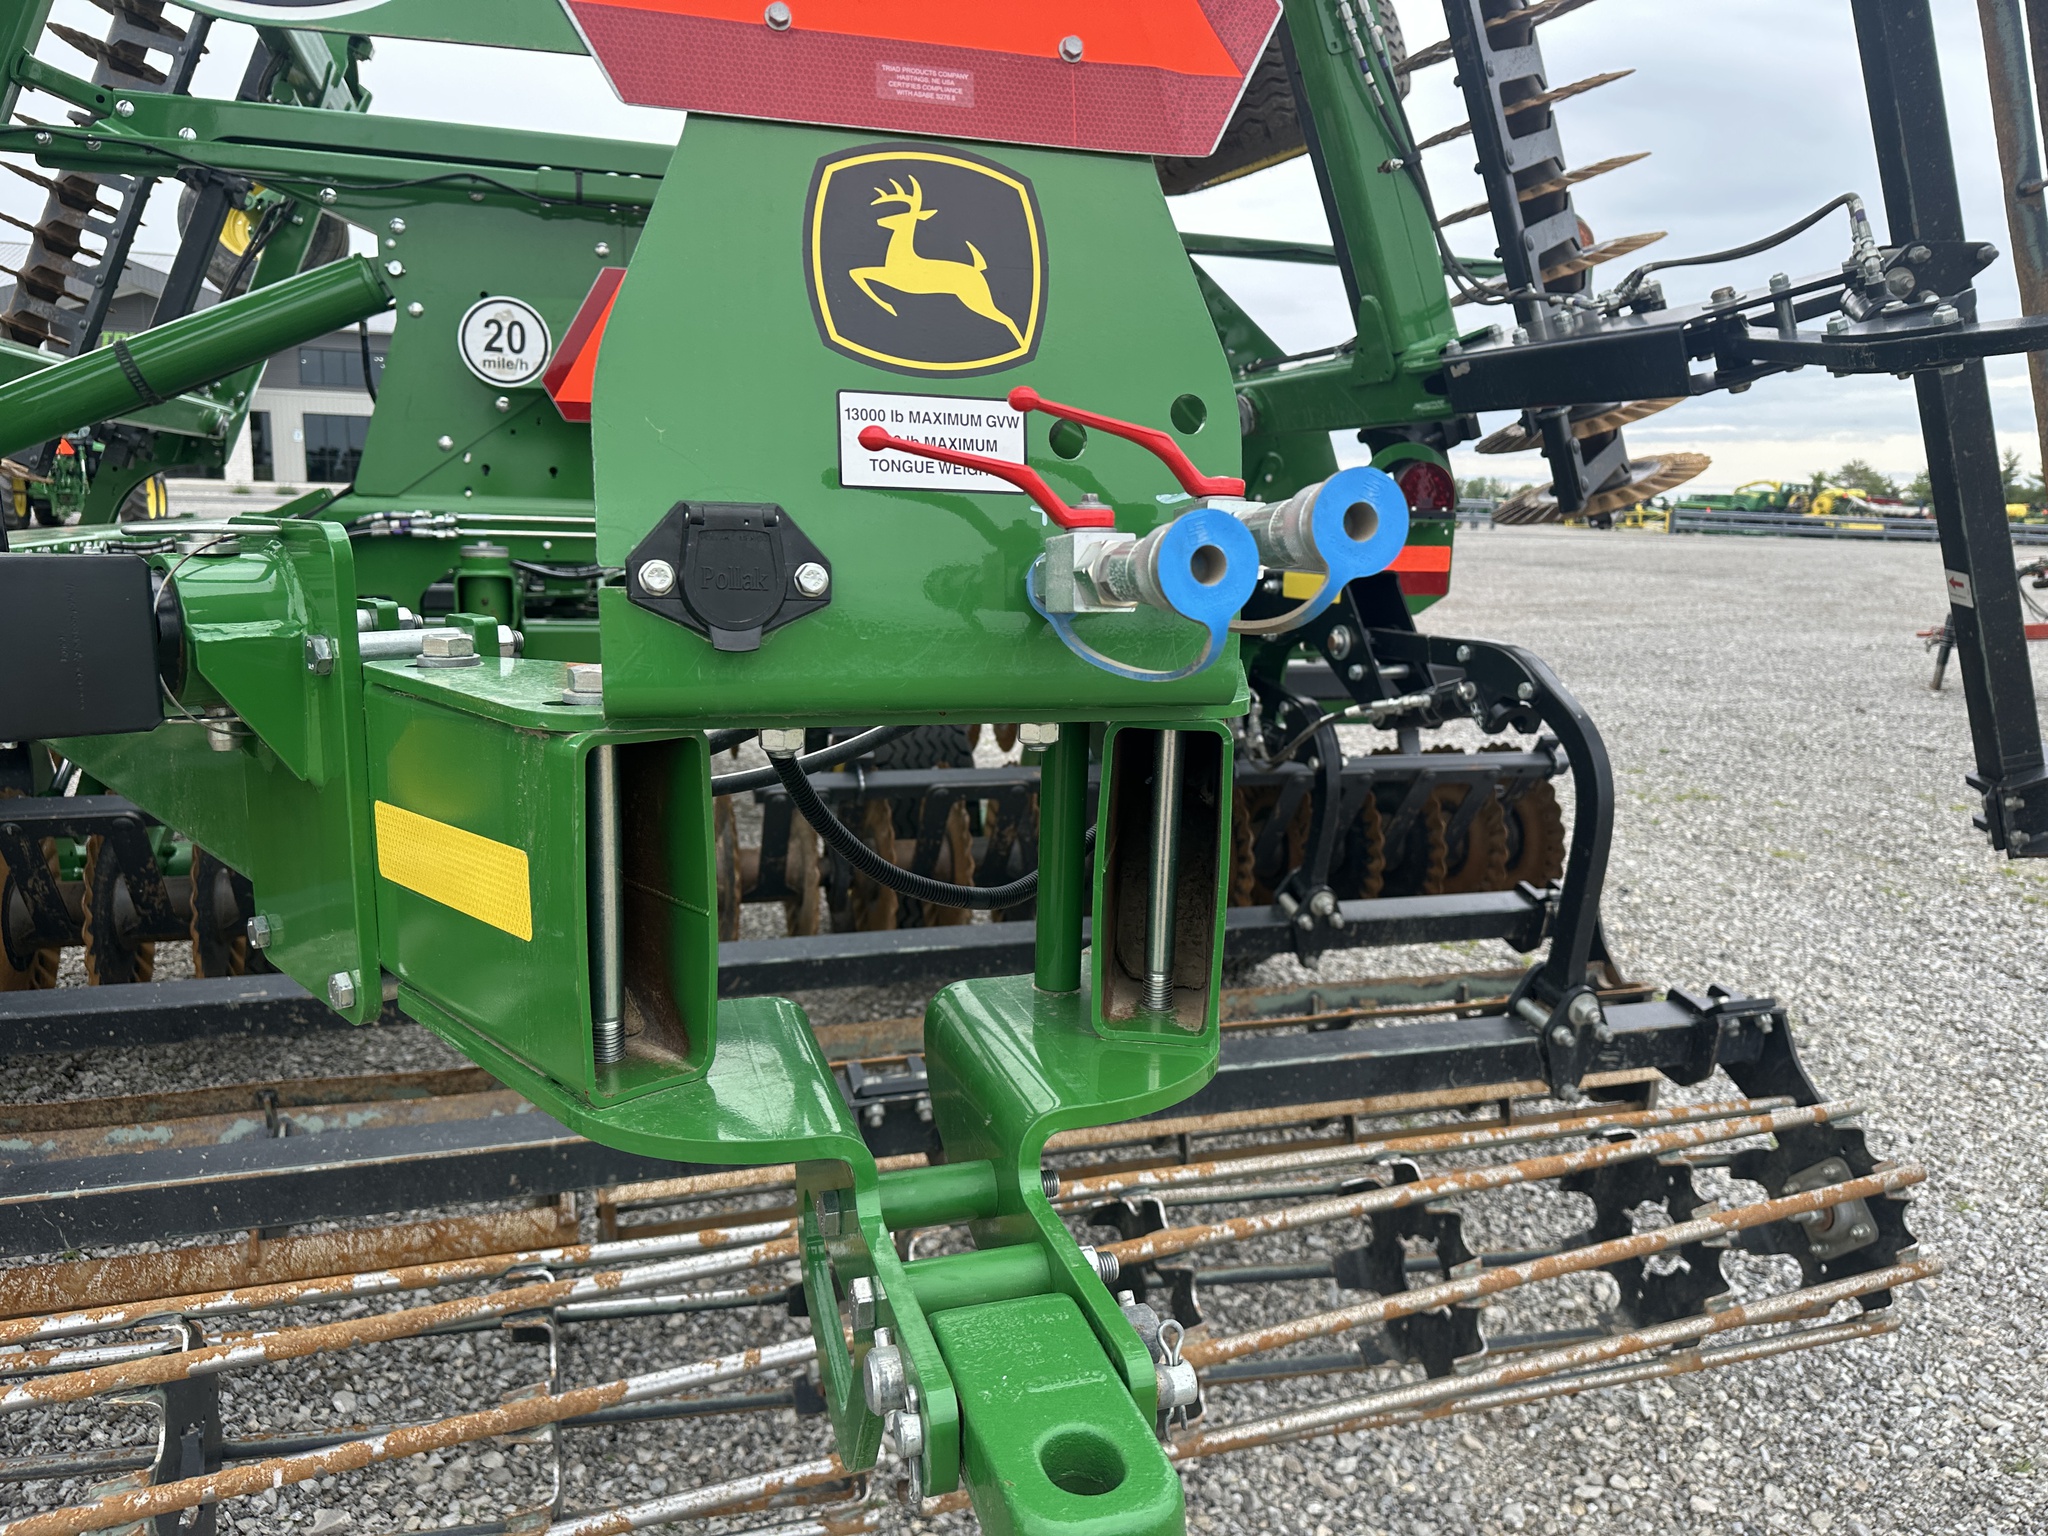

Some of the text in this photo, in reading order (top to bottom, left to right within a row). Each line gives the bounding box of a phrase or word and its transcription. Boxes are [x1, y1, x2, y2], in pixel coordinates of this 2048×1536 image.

[902, 68, 936, 76] PRODUCTS
[938, 71, 968, 80] COMPANY
[888, 81, 963, 94] CERTIFIES COMPLIANCE
[914, 91, 934, 99] ASABE
[484, 319, 525, 354] 20
[483, 357, 528, 371] mile/h
[845, 408, 1020, 429] 13000 lb MAXIMUM GVW
[924, 436, 997, 452] MAXIMUM
[870, 459, 988, 476] TONGUE WEIG
[700, 566, 768, 591] Pollak
